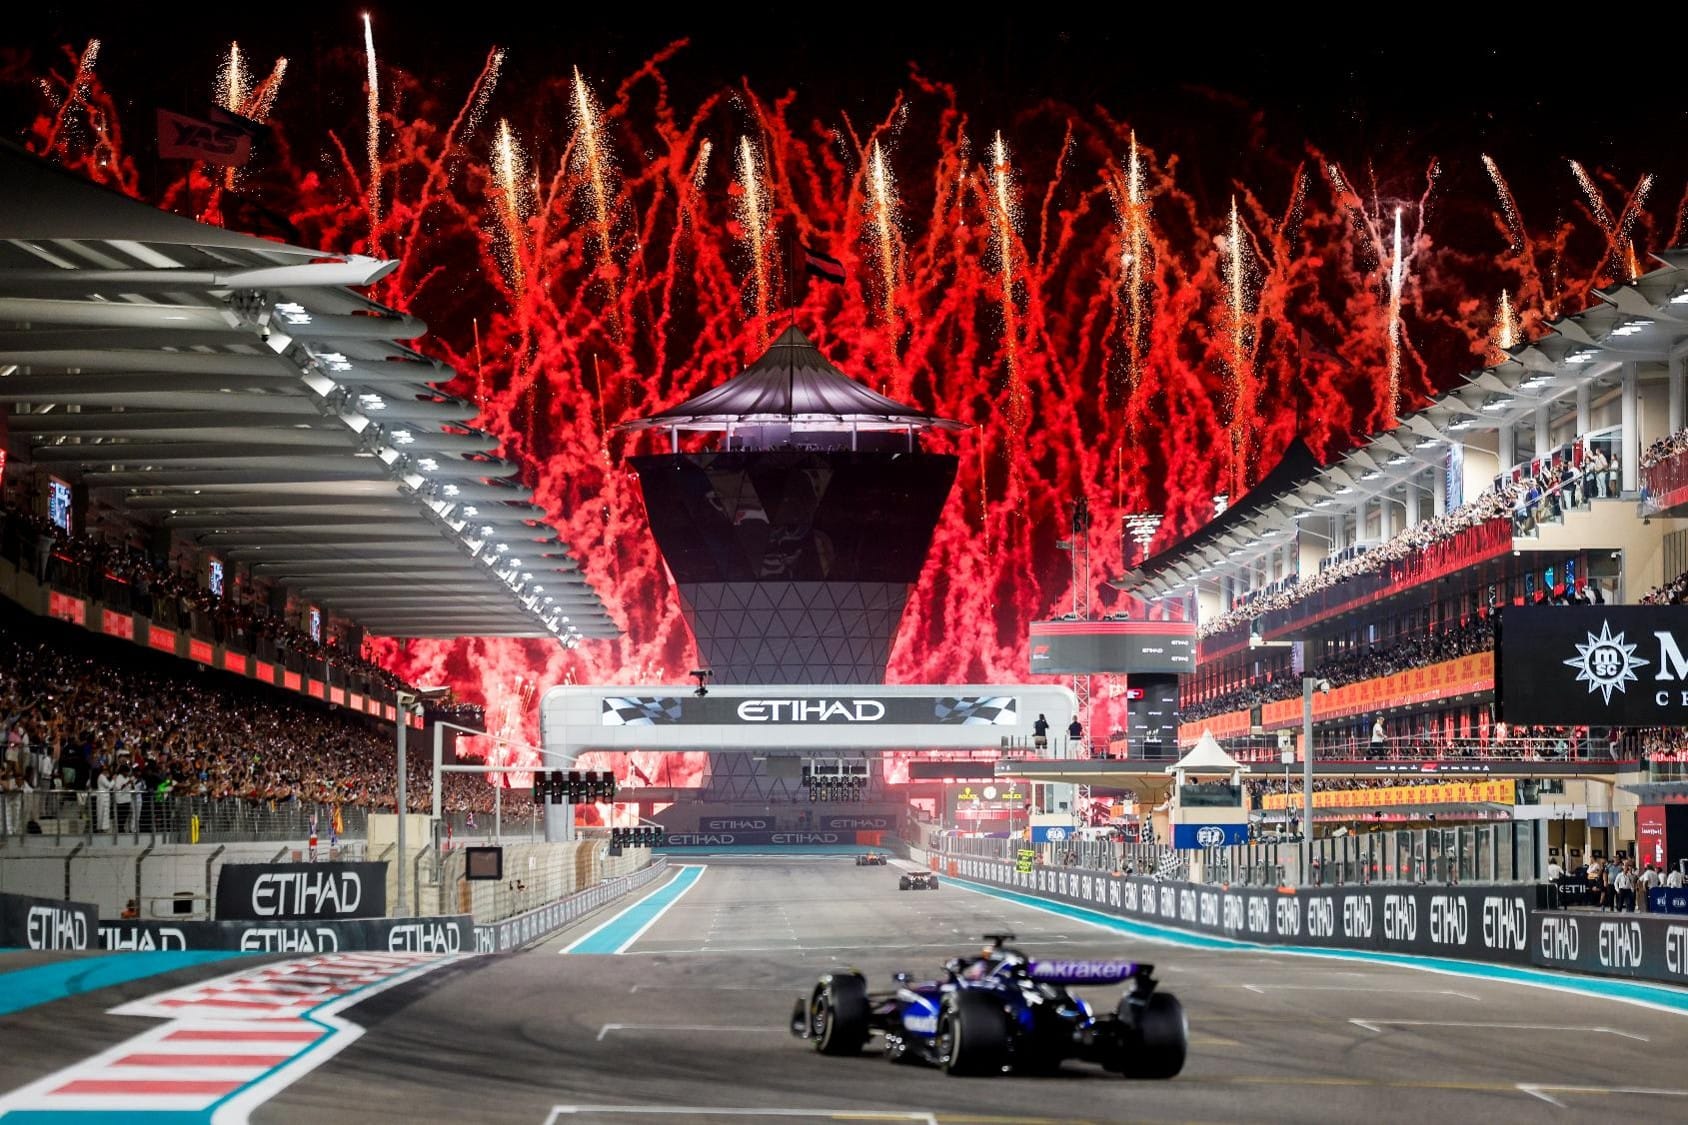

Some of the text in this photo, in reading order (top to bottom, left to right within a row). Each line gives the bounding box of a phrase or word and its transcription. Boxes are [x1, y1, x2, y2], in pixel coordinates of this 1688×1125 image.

[172, 119, 240, 155] YAS
[737, 700, 885, 721] ETIHAD
[668, 834, 734, 845] ETIHAD
[709, 820, 766, 829] ETIHAD
[771, 833, 838, 844] ETIHAD
[830, 818, 887, 828] ETIHAD
[252, 872, 361, 916] ETIHAD
[27, 905, 87, 951] ETIHAD
[1276, 896, 1300, 935] ETIHAD
[1308, 896, 1334, 936] ETIHAD
[1344, 895, 1373, 938] ETIHAD
[1384, 894, 1416, 941] ETIHAD
[1430, 896, 1468, 945] ETIHAD
[1483, 896, 1526, 950] ETIHAD
[98, 927, 186, 952] TIHAD
[388, 922, 460, 954] ETIHAD
[474, 927, 495, 953] TIHAD
[1541, 918, 1579, 961] ETIHAD
[1599, 921, 1643, 967] ETIHAD
[1055, 960, 1131, 978] kraken
